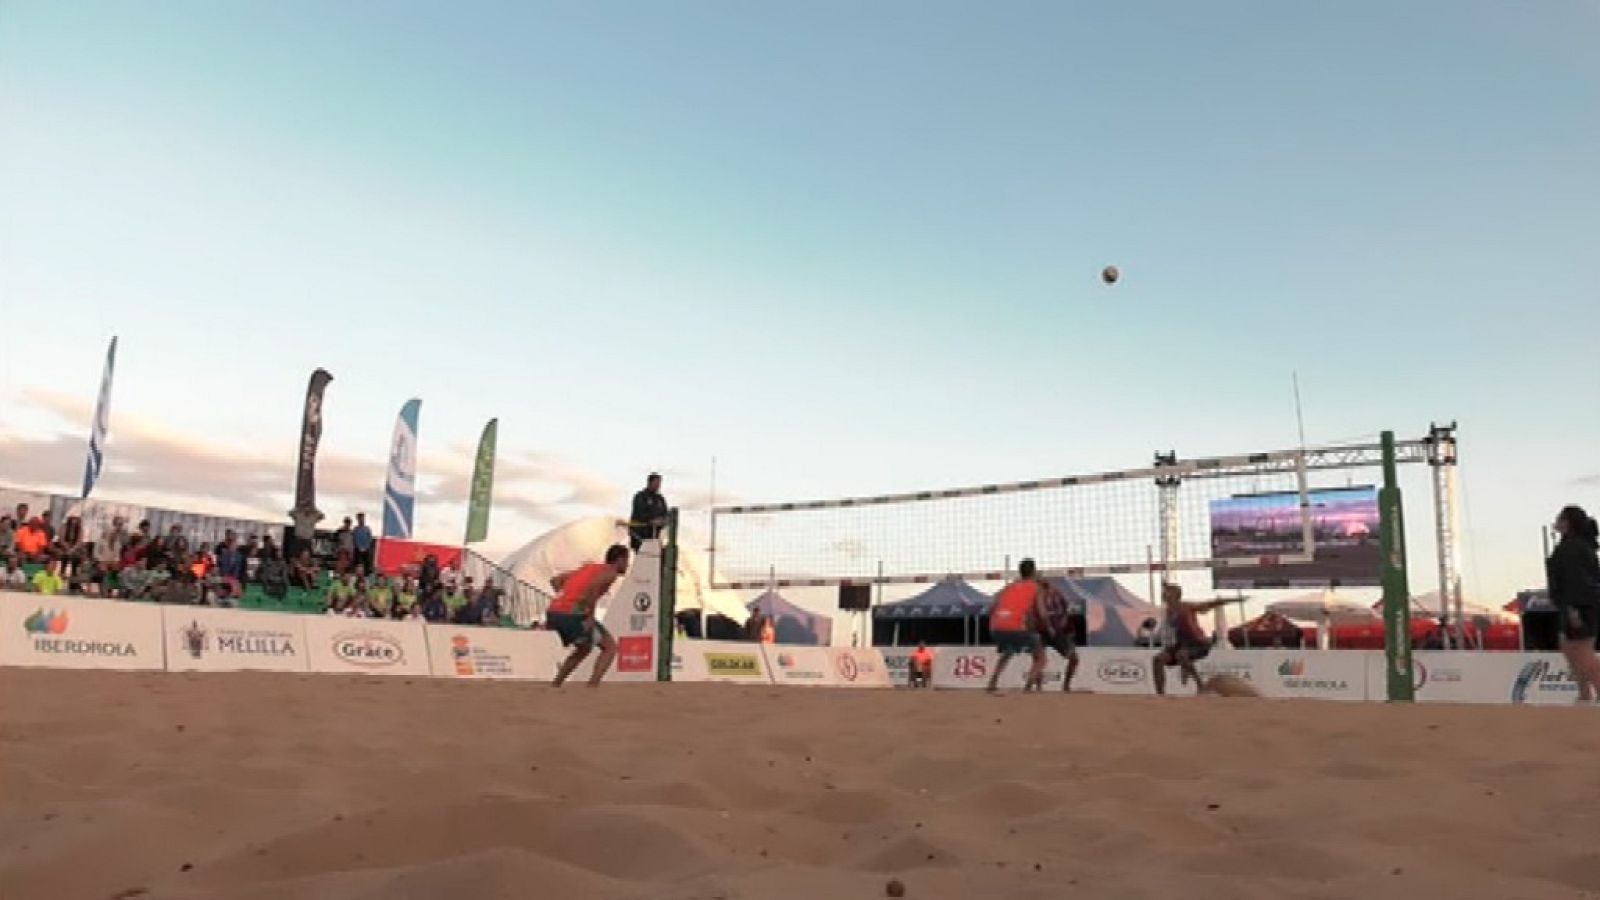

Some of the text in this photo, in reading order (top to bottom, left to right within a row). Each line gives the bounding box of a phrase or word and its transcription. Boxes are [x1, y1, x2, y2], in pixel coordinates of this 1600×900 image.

[34, 639, 137, 657] IBERDROLA
[218, 636, 295, 656] MELILLA
[342, 643, 394, 659] Grace
[953, 655, 986, 678] as
